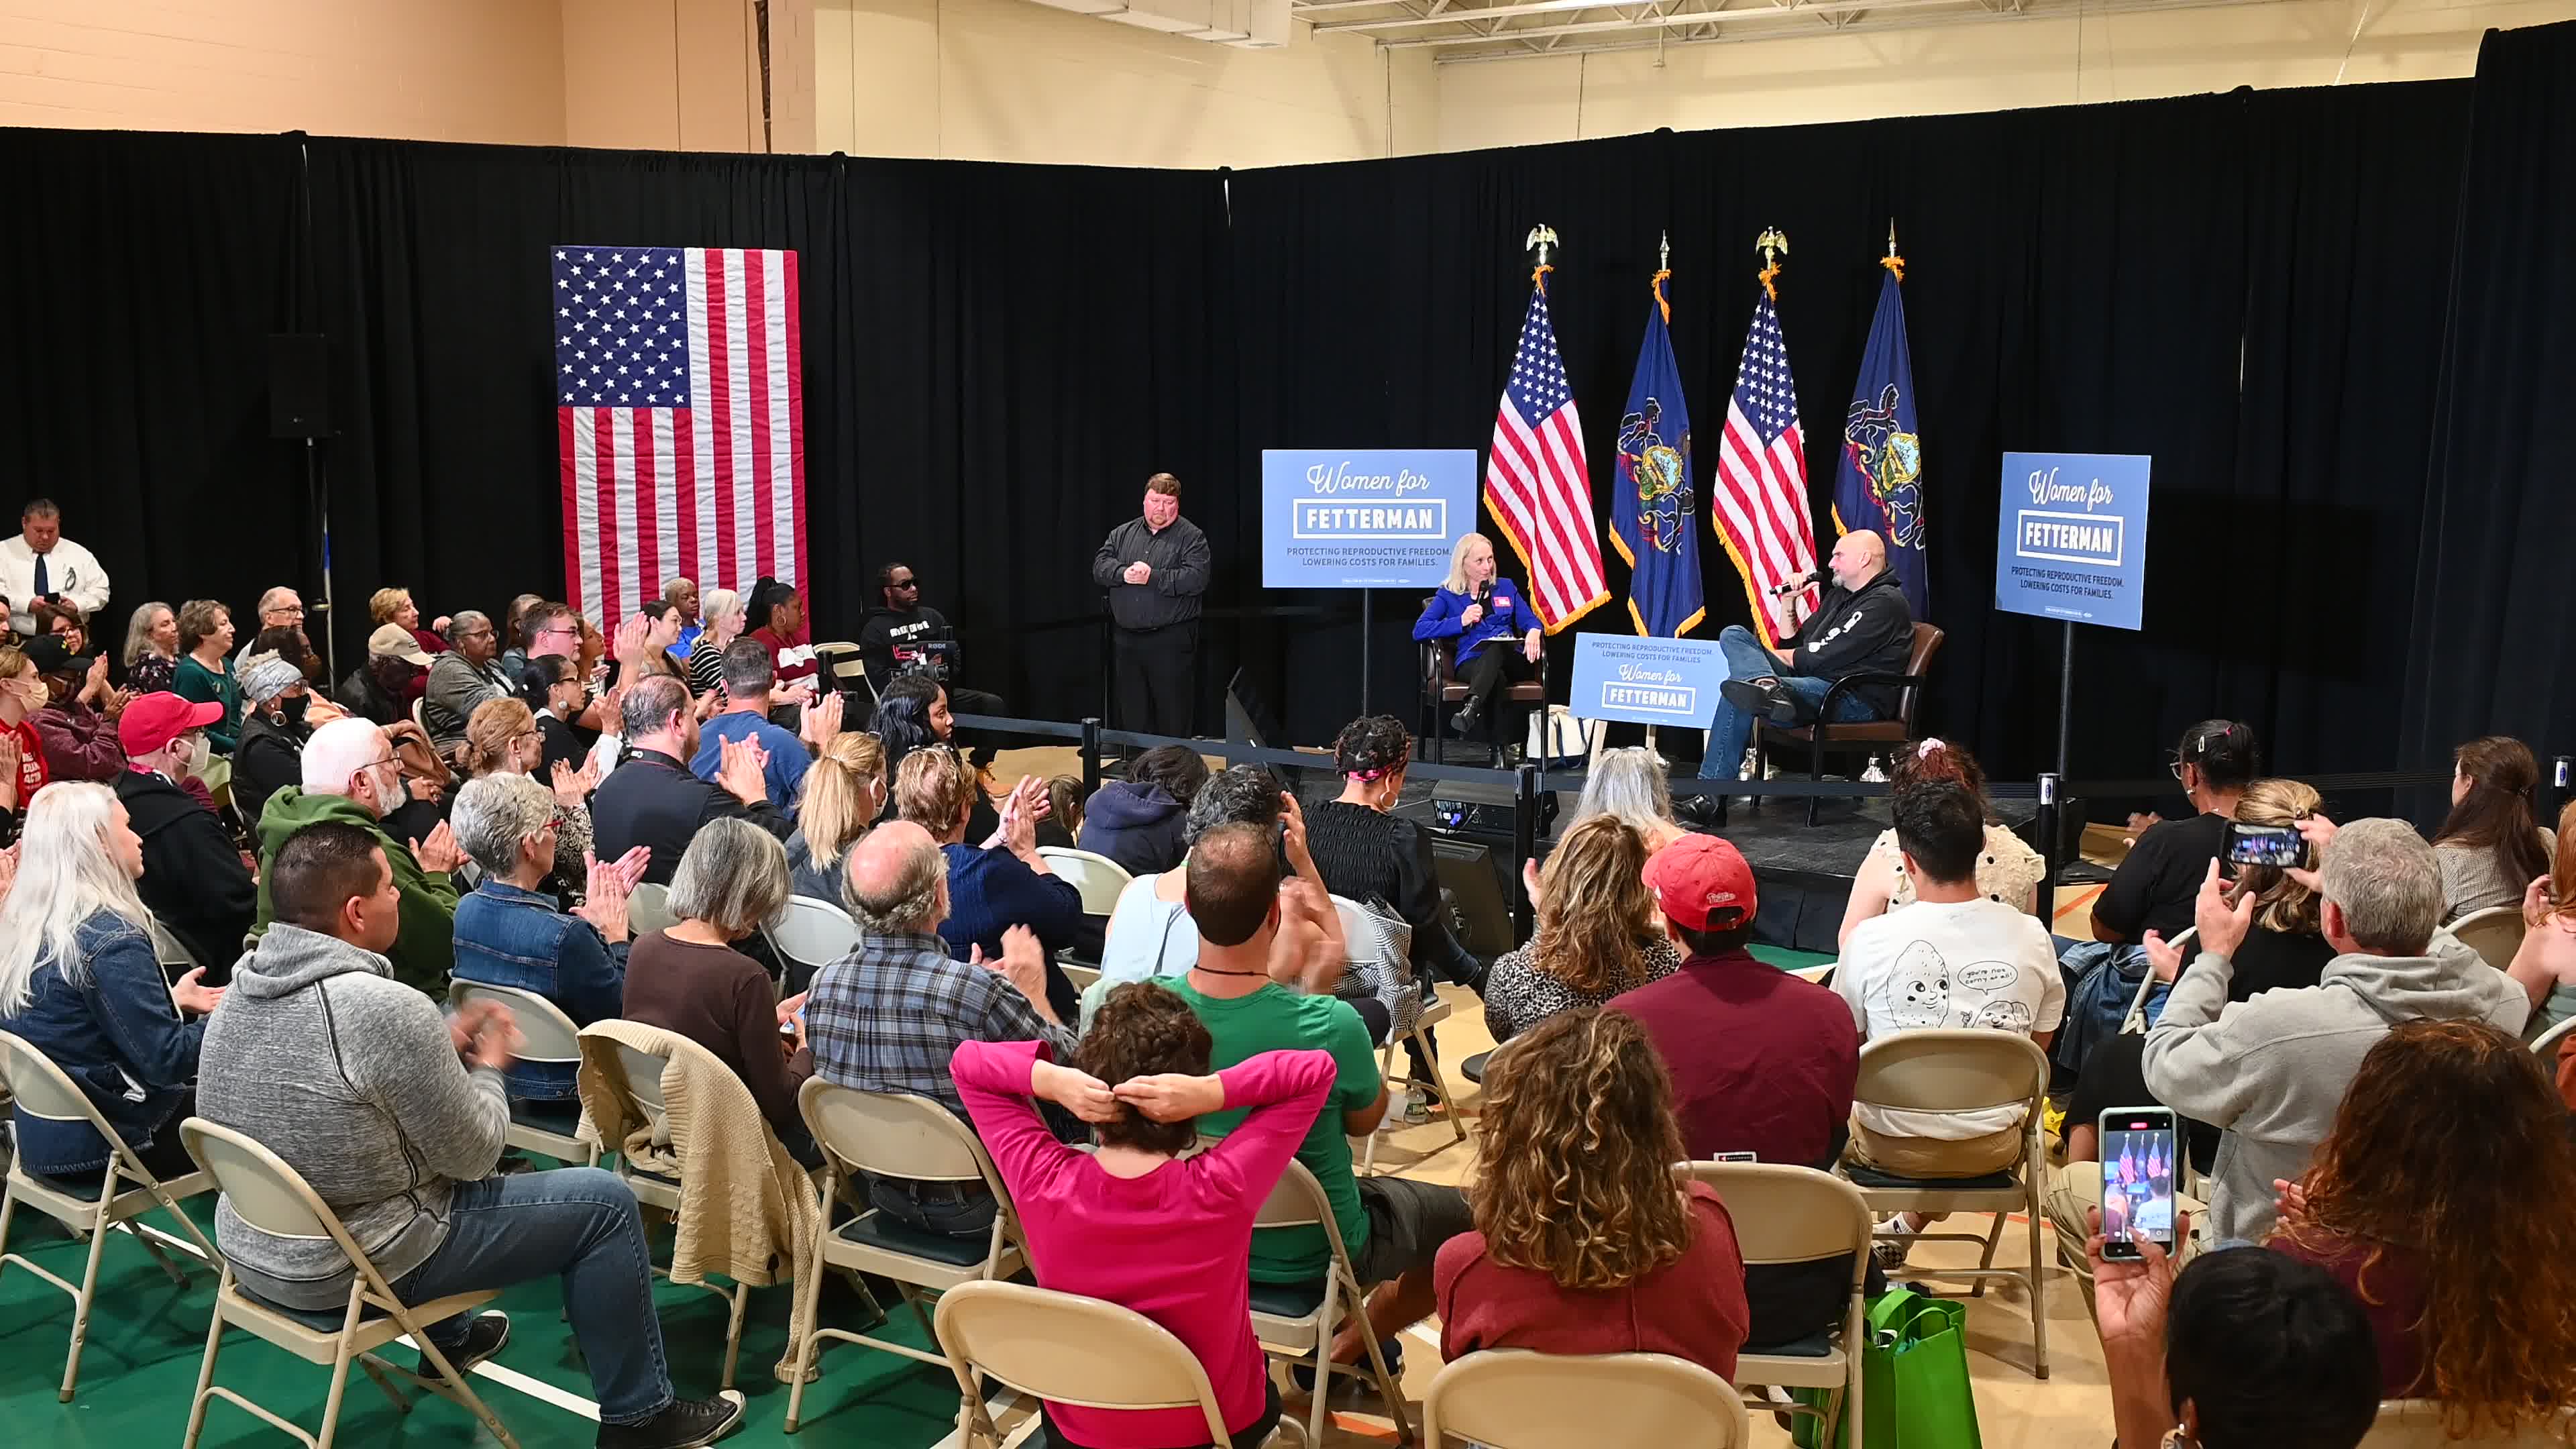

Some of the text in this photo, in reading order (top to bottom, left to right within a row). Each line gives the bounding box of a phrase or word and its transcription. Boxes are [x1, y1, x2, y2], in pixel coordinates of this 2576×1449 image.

[1306, 461, 1430, 497] Women for
[2029, 467, 2114, 512] Women for
[1307, 508, 1432, 529] FETTERMAN
[2025, 522, 2113, 553] FETTERMAN
[1287, 547, 1340, 555] PROTECTING
[1342, 547, 1407, 555] REPRODUCTIVE
[1303, 558, 1438, 566] LOWERING COSTS FOR FAMILIES.
[2011, 566, 2046, 578] PROTECTING
[2047, 570, 2092, 584] REPRODUCTIVE
[2021, 579, 2050, 591] LOWERING
[2051, 583, 2070, 594] COSTS
[2071, 586, 2083, 596] FOR
[1618, 663, 1683, 685] Women for
[1609, 688, 1687, 708] FETTERMAN
